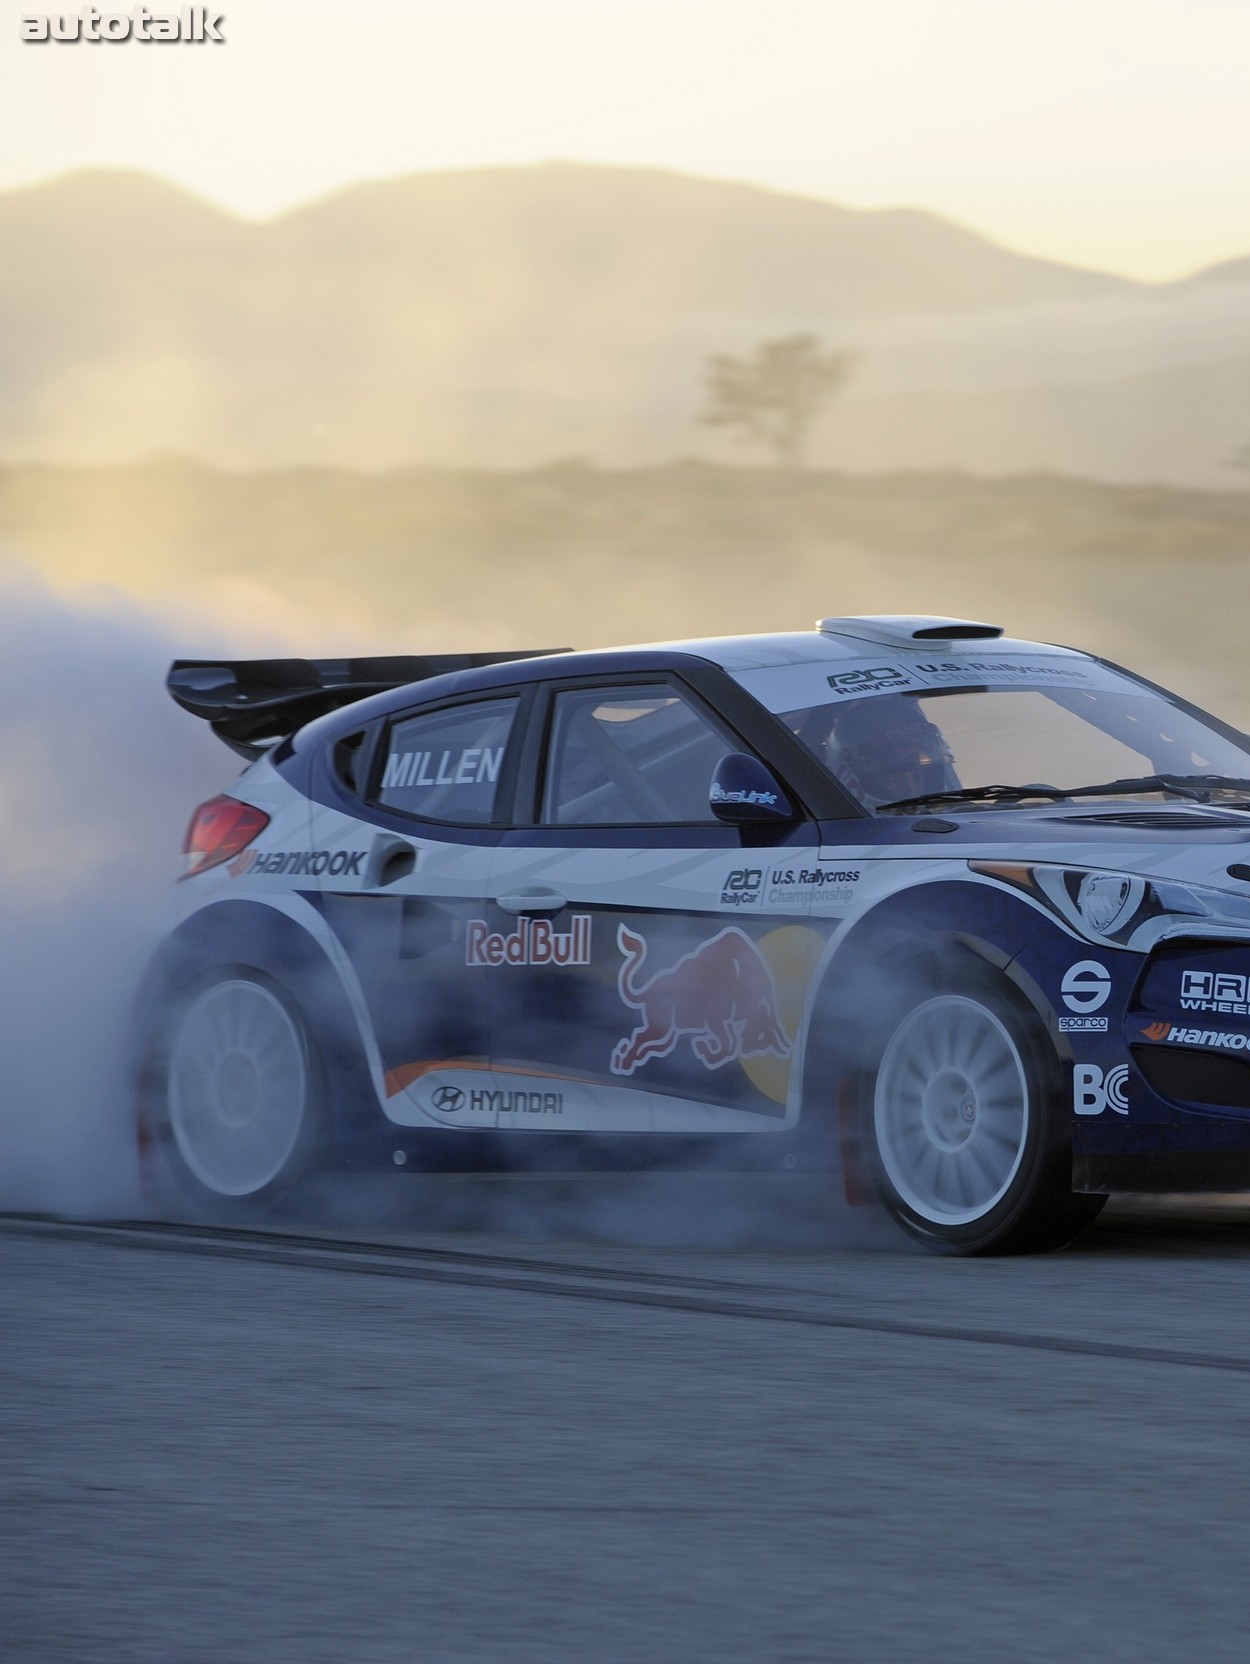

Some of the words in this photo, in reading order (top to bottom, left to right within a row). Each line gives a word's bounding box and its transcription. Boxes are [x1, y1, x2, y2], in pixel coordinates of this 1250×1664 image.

[915, 662, 970, 673] U.S.
[971, 663, 1088, 678] Rallycross
[834, 676, 911, 695] RallyCar
[381, 748, 504, 788] MILLEN
[771, 870, 796, 885] U.S.
[799, 869, 860, 887] Rallycross
[720, 892, 758, 906] RallyCar
[767, 887, 854, 906] Championship
[465, 916, 529, 966] Red
[528, 915, 592, 966] Bull
[1060, 1018, 1107, 1028] sparco
[471, 1090, 563, 1114] HYUNDAI
